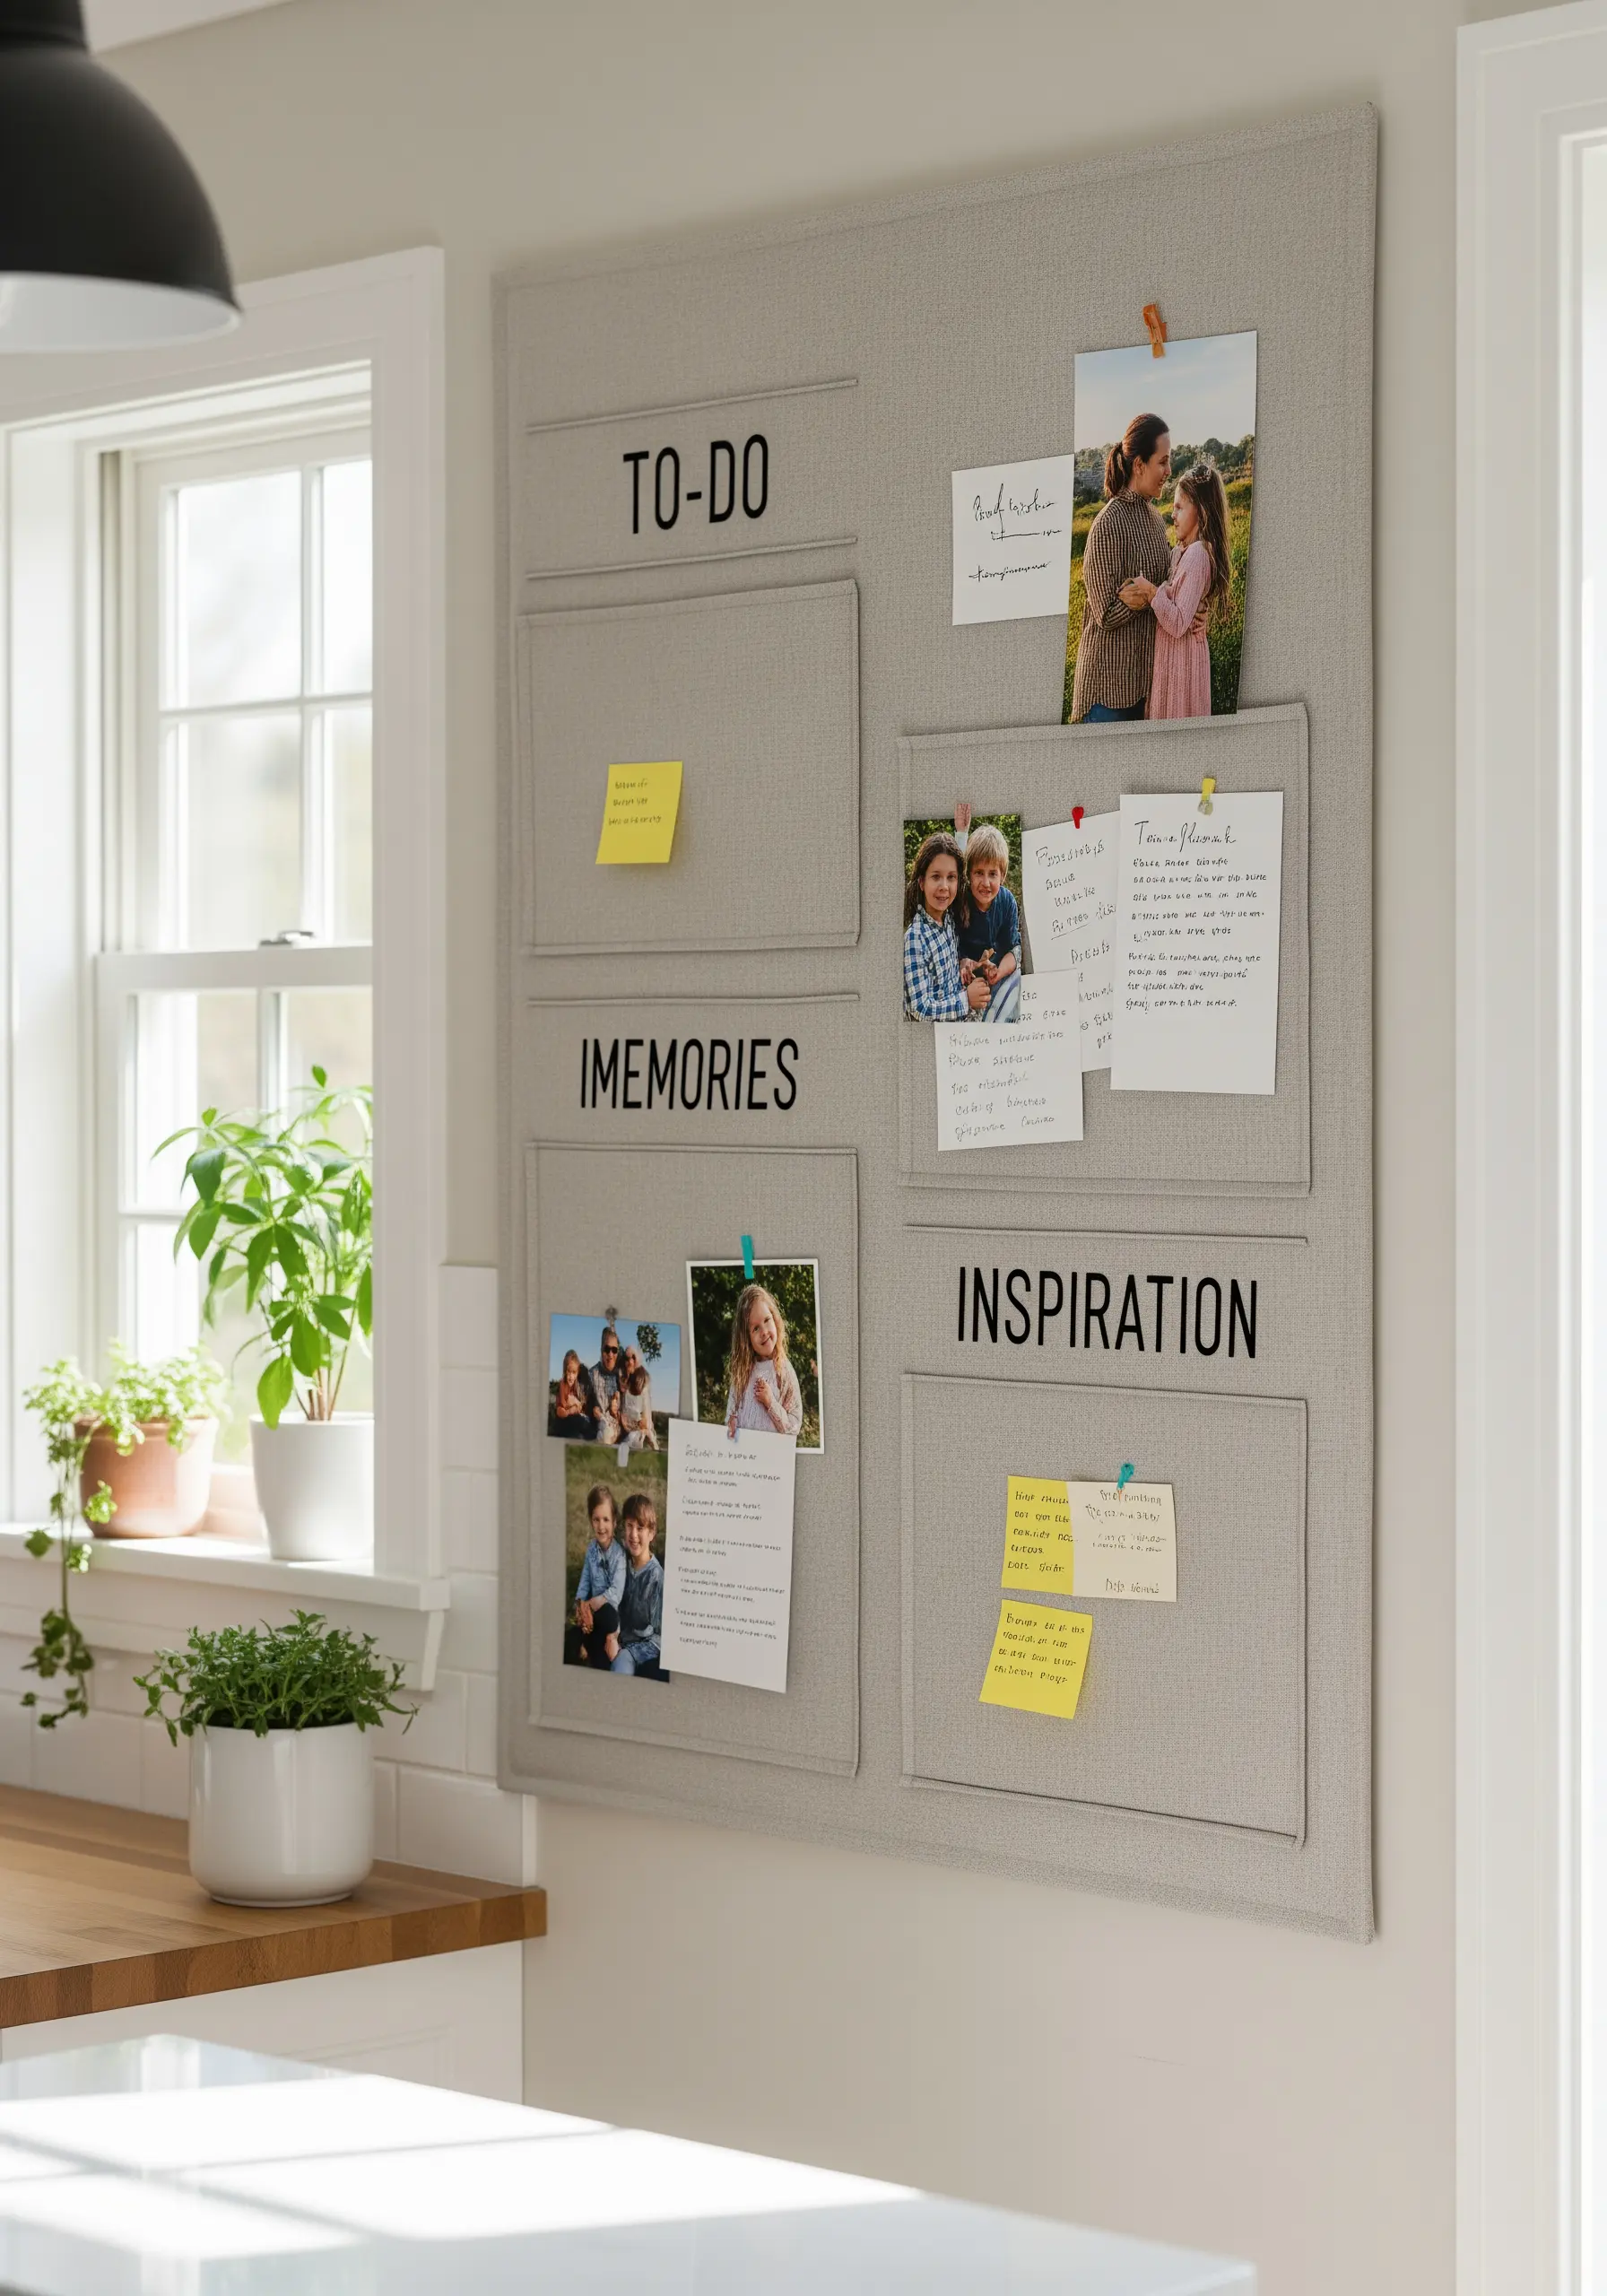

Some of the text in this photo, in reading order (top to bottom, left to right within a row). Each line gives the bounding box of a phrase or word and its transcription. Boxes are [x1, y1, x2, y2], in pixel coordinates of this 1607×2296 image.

[623, 434, 768, 534] TO-DO
[581, 1039, 798, 1110] IMEMORIES
[959, 1267, 1256, 1358] INSPIRATION
